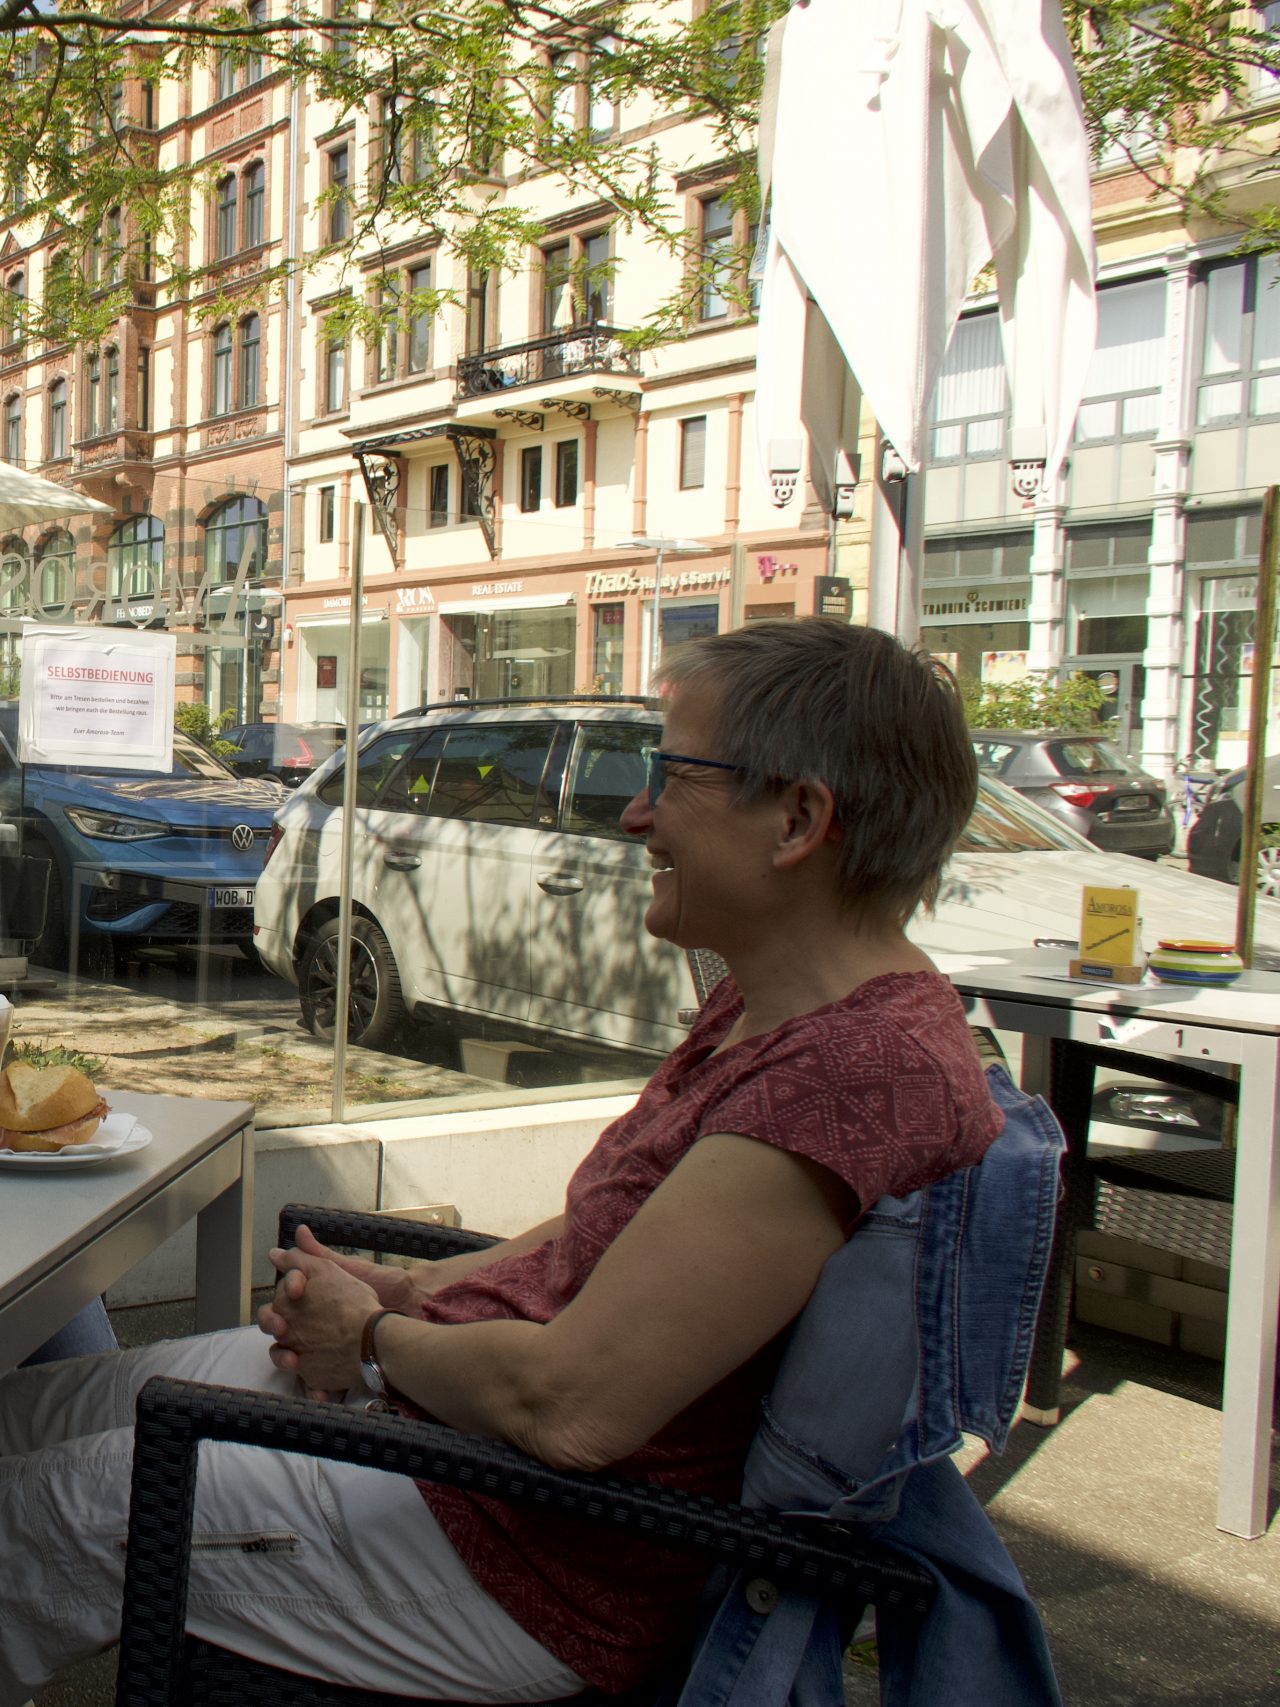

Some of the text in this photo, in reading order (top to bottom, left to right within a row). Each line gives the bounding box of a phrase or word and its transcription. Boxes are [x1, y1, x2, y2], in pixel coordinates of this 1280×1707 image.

[472, 581, 523, 596] REAL ESTATE
[47, 665, 153, 685] SELBSTBEDIENUNG
[74, 695, 90, 703] Tresen
[216, 890, 238, 905] WOB
[1175, 1029, 1183, 1048] 1
